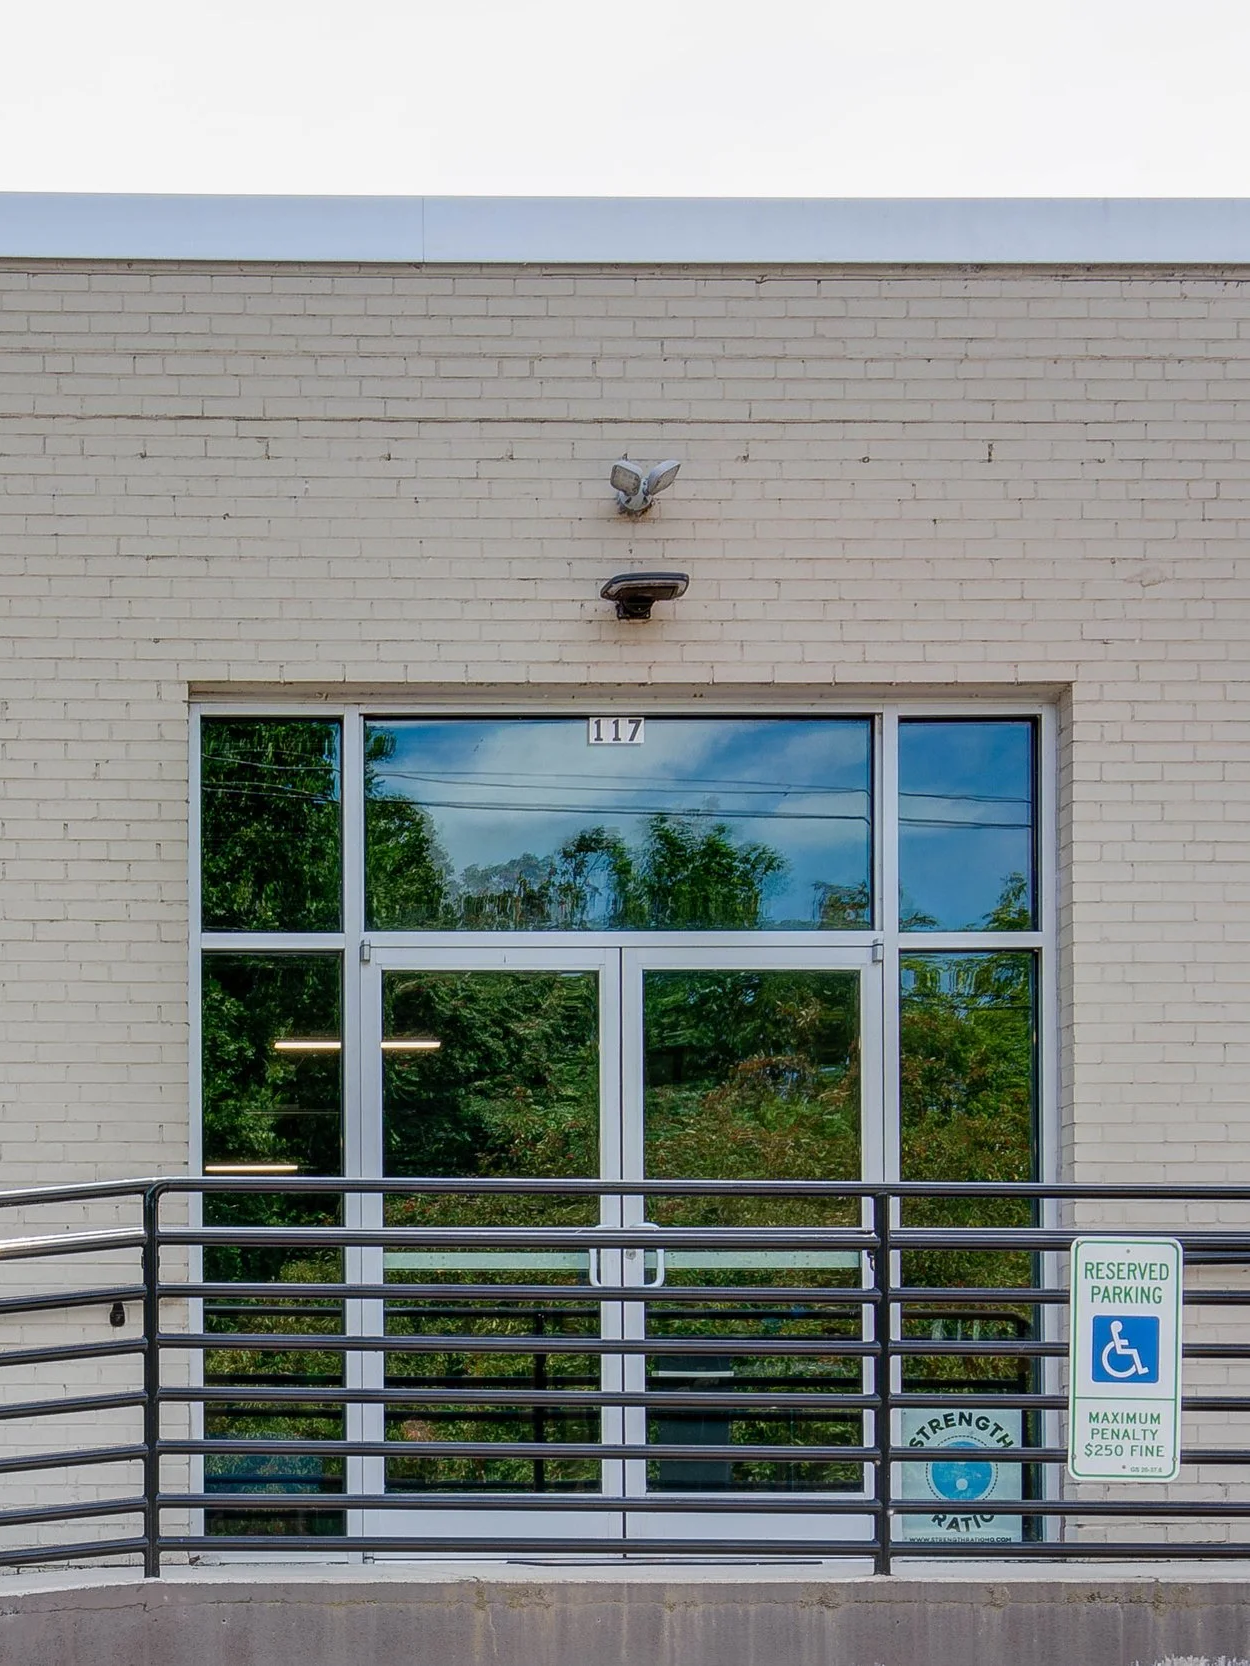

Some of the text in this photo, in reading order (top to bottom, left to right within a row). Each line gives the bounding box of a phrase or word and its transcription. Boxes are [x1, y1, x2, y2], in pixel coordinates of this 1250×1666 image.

[594, 718, 642, 742] 117
[1084, 1262, 1170, 1281] RESERVED
[1091, 1285, 1163, 1305] PARKING
[1088, 1411, 1161, 1425] MAXIMUM
[909, 1411, 1014, 1448] STRENGTH
[1090, 1427, 1158, 1441] PENALTY
[1084, 1443, 1165, 1457] $250 FINE
[931, 1513, 995, 1532] RATIO
